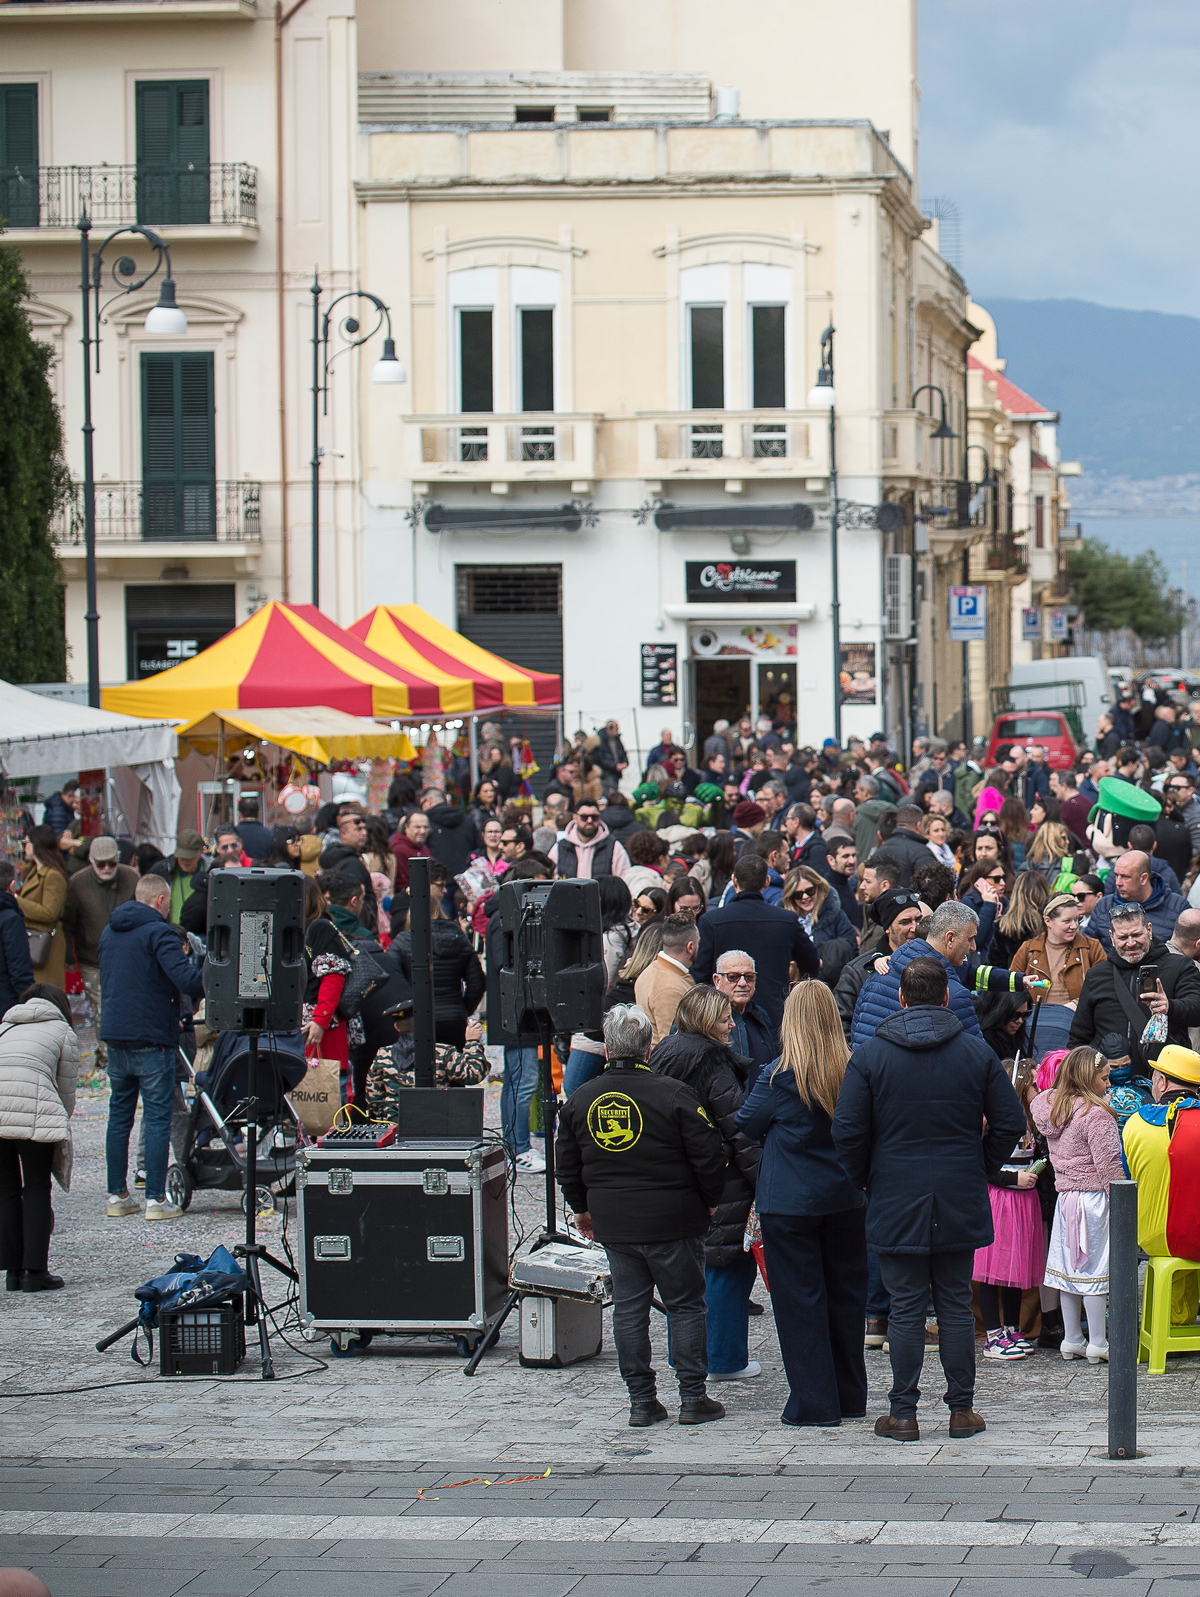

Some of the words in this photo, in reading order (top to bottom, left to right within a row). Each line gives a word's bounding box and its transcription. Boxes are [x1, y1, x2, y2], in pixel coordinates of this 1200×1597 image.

[961, 598, 974, 614] P
[242, 920, 254, 980] OPERA
[290, 1091, 328, 1103] PRIMIGI
